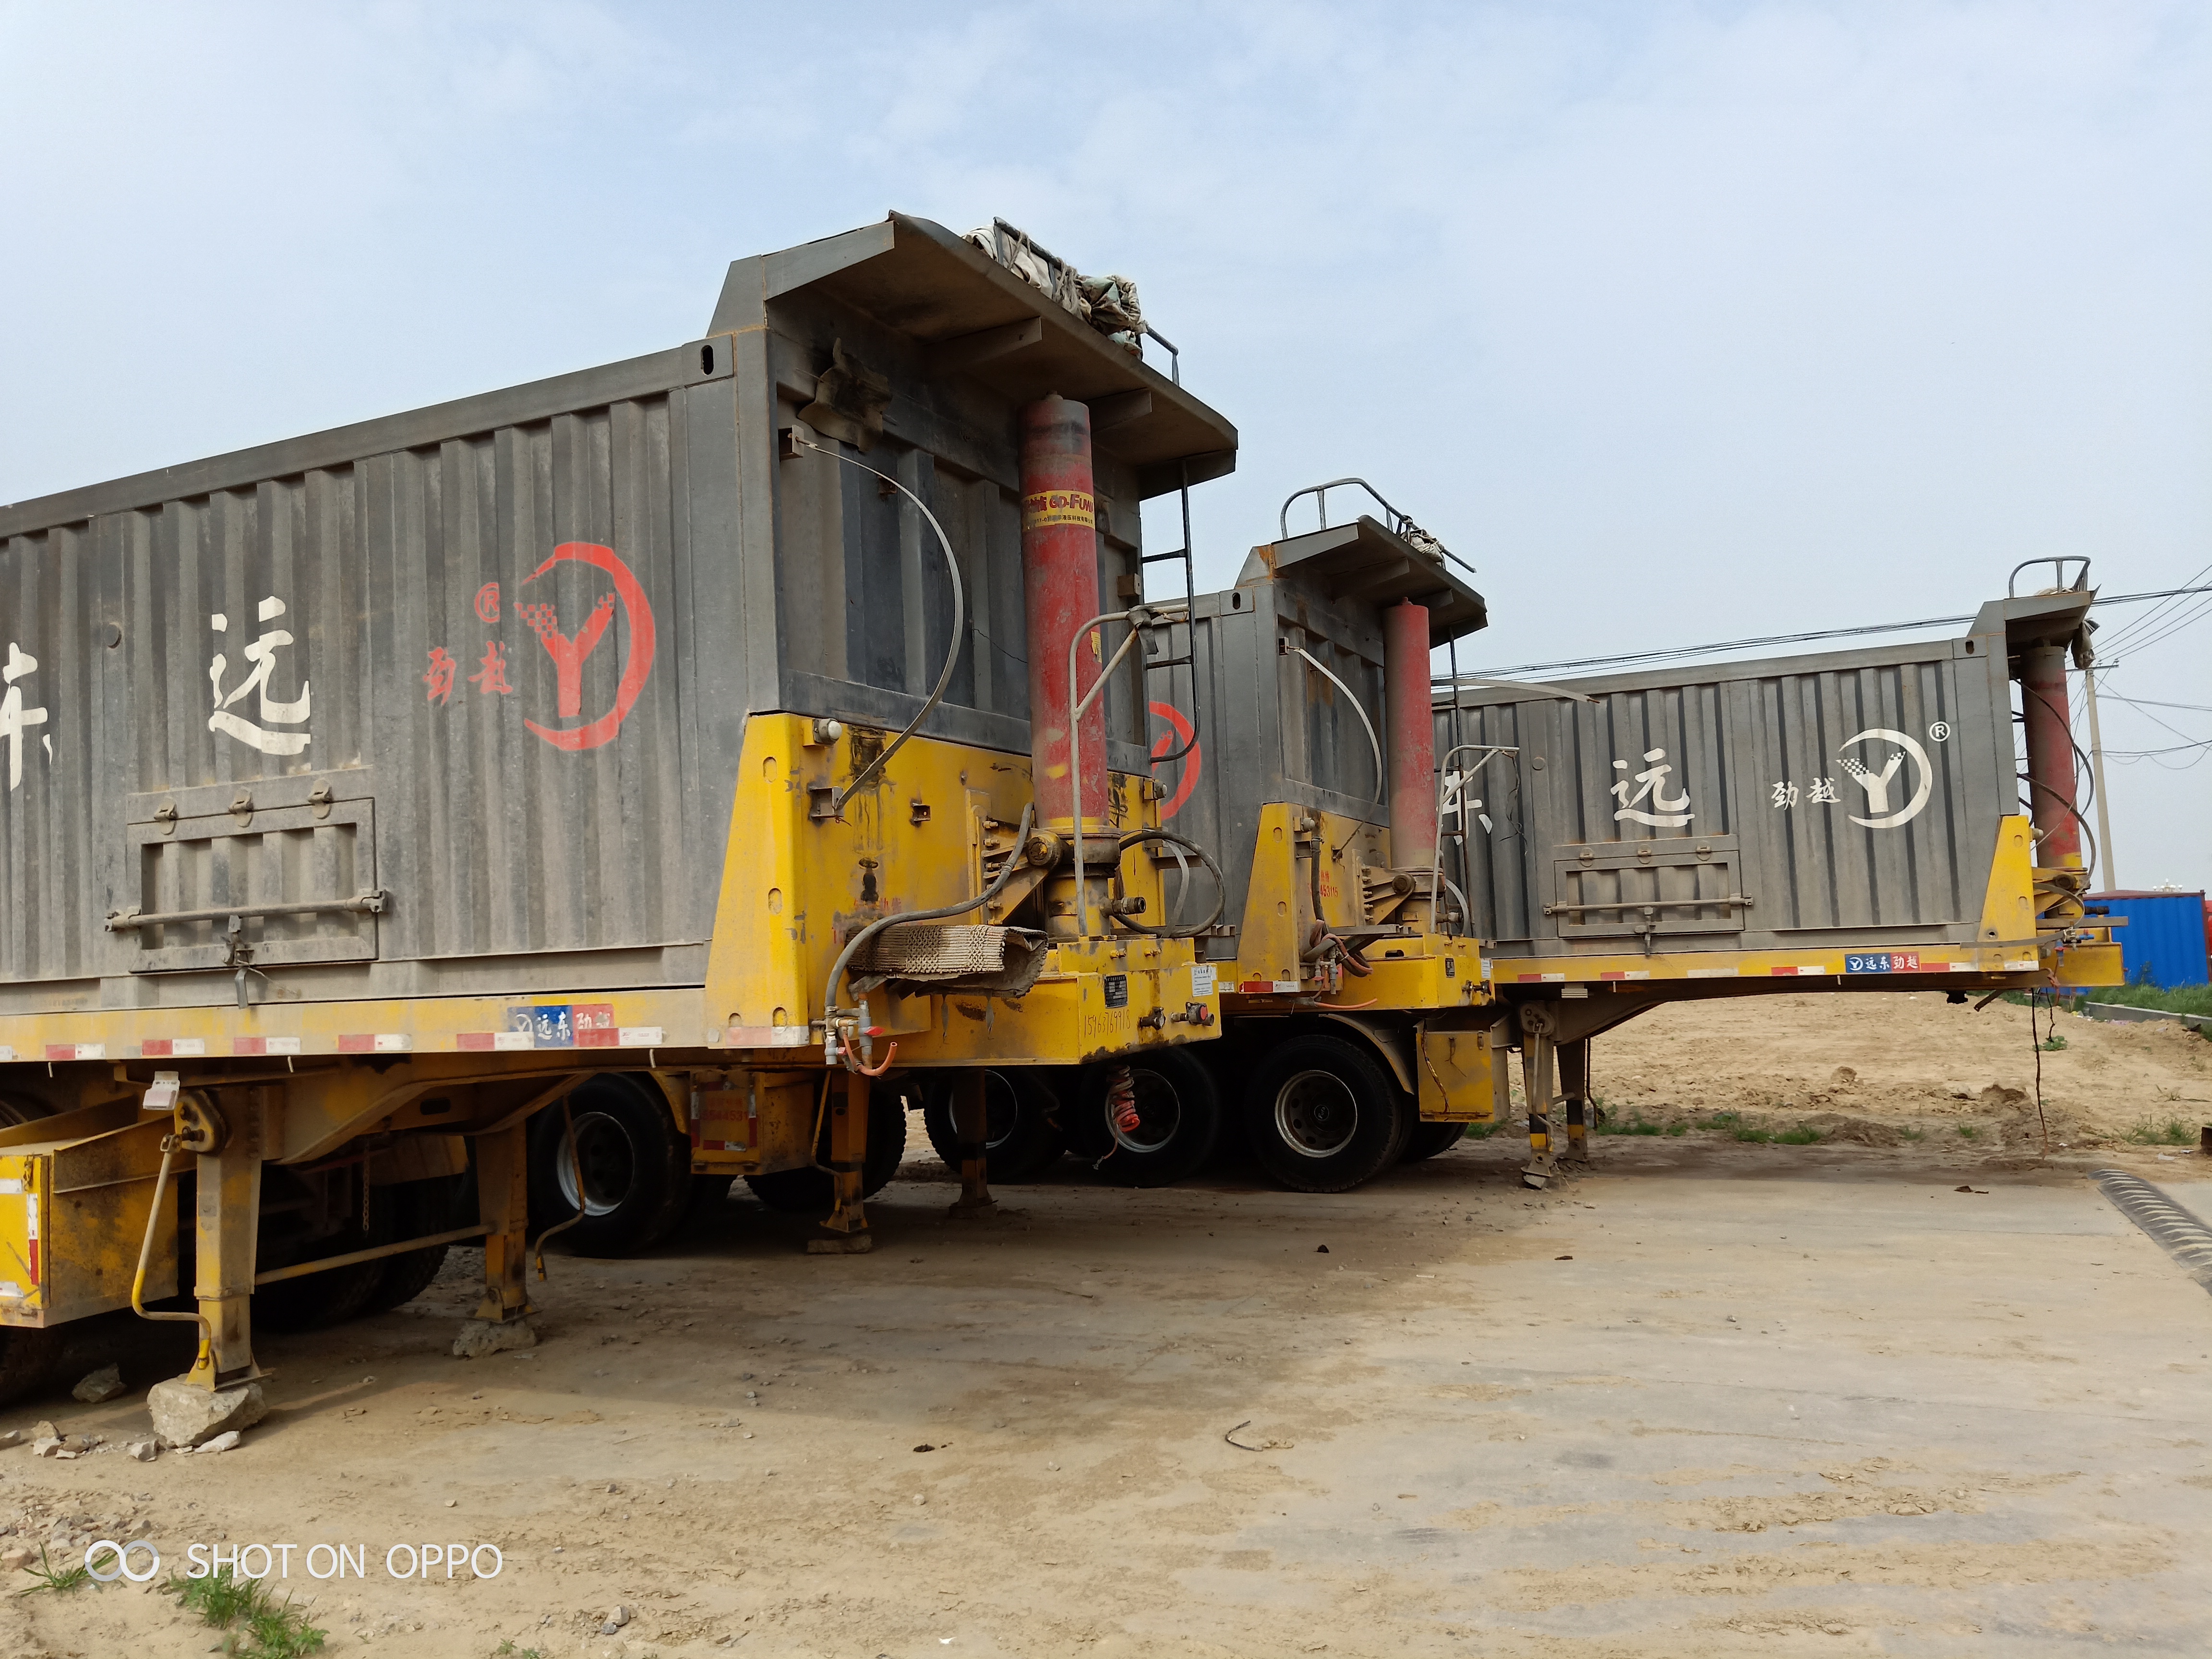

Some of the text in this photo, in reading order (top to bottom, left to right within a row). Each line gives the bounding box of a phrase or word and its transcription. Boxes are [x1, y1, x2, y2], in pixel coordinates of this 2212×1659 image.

[208, 595, 311, 756] 远
[1610, 747, 1695, 828] 远
[1771, 777, 1841, 811] 劲越
[1084, 1009, 1130, 1038] 15963769918
